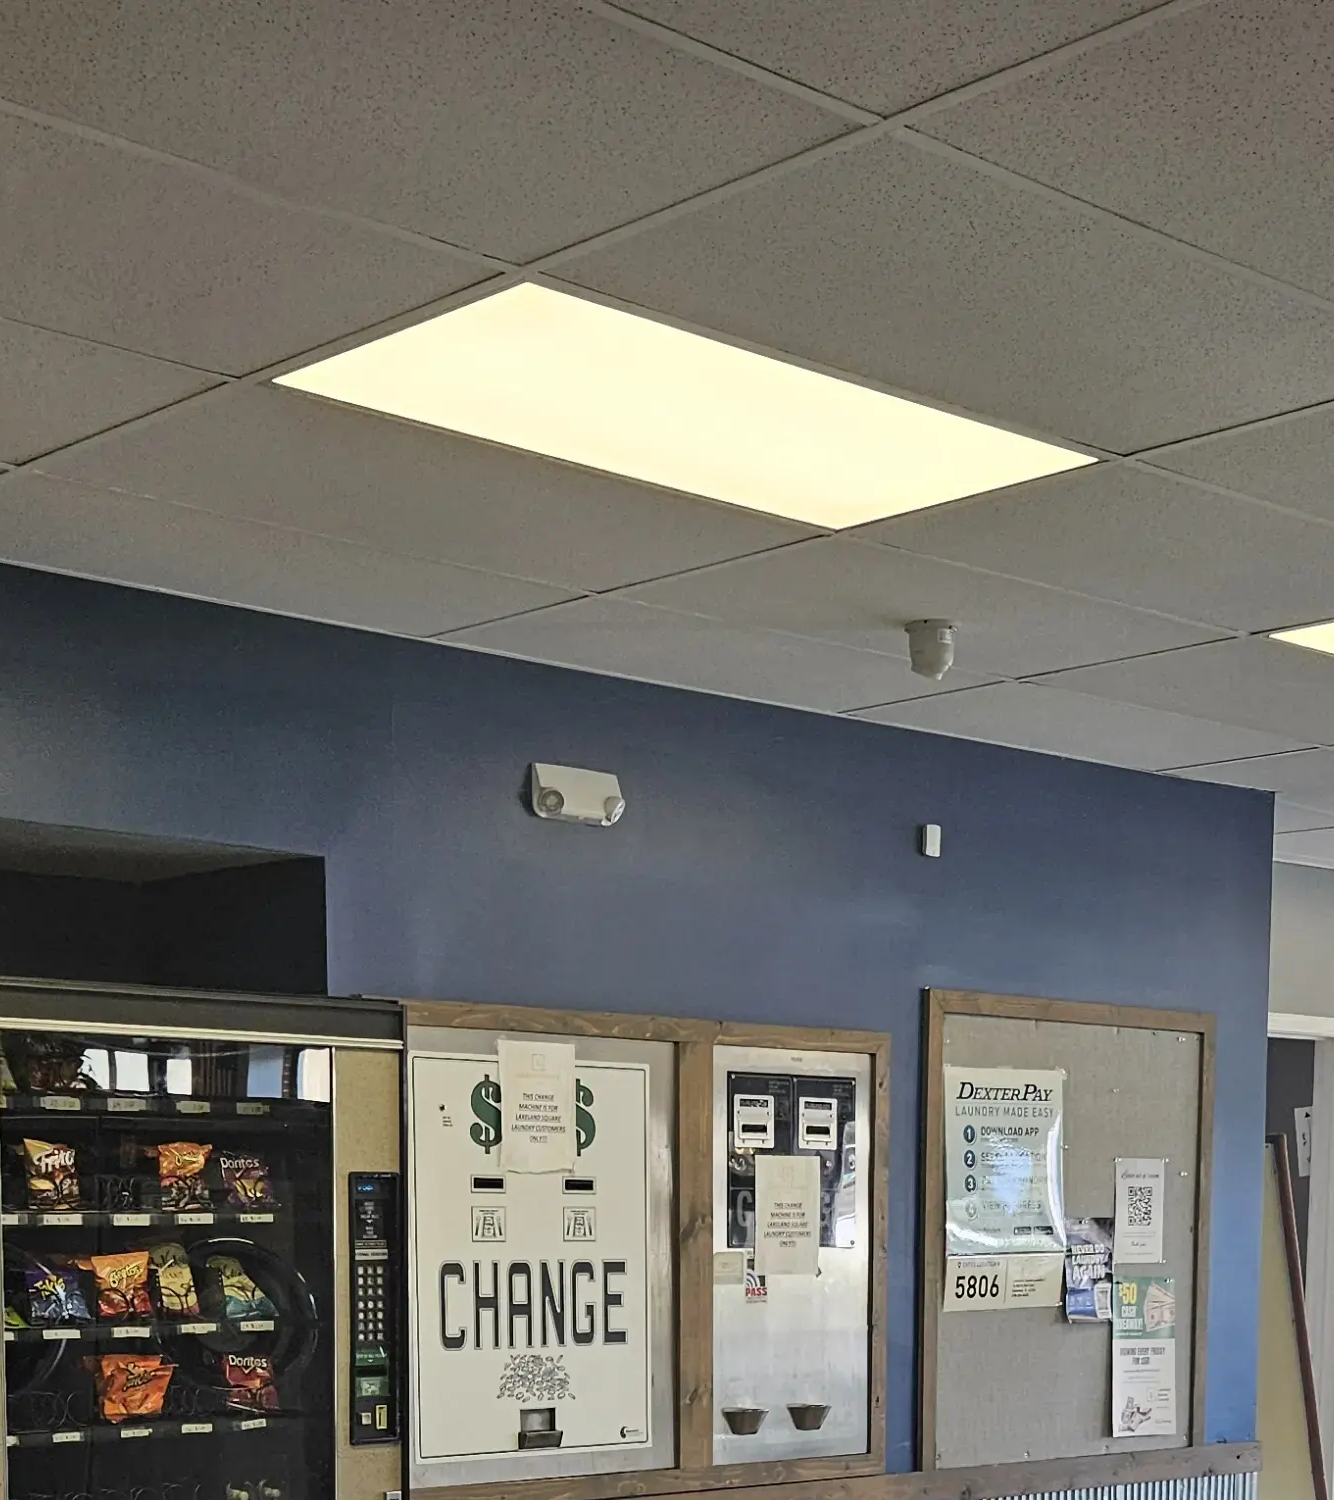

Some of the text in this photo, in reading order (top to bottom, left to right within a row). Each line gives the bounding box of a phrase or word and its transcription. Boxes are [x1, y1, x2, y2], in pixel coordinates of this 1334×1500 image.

[955, 1106, 1055, 1118] LAUNDRY MADE EASY
[980, 1127, 1040, 1137] DOWNLOAD APP
[220, 1157, 260, 1169] Doritos
[1073, 1265, 1106, 1280] AGAIN
[745, 1287, 767, 1297] PASS
[955, 1275, 1000, 1298] 5806
[439, 1259, 628, 1350] CHANGE
[228, 1354, 268, 1367] Doritos
